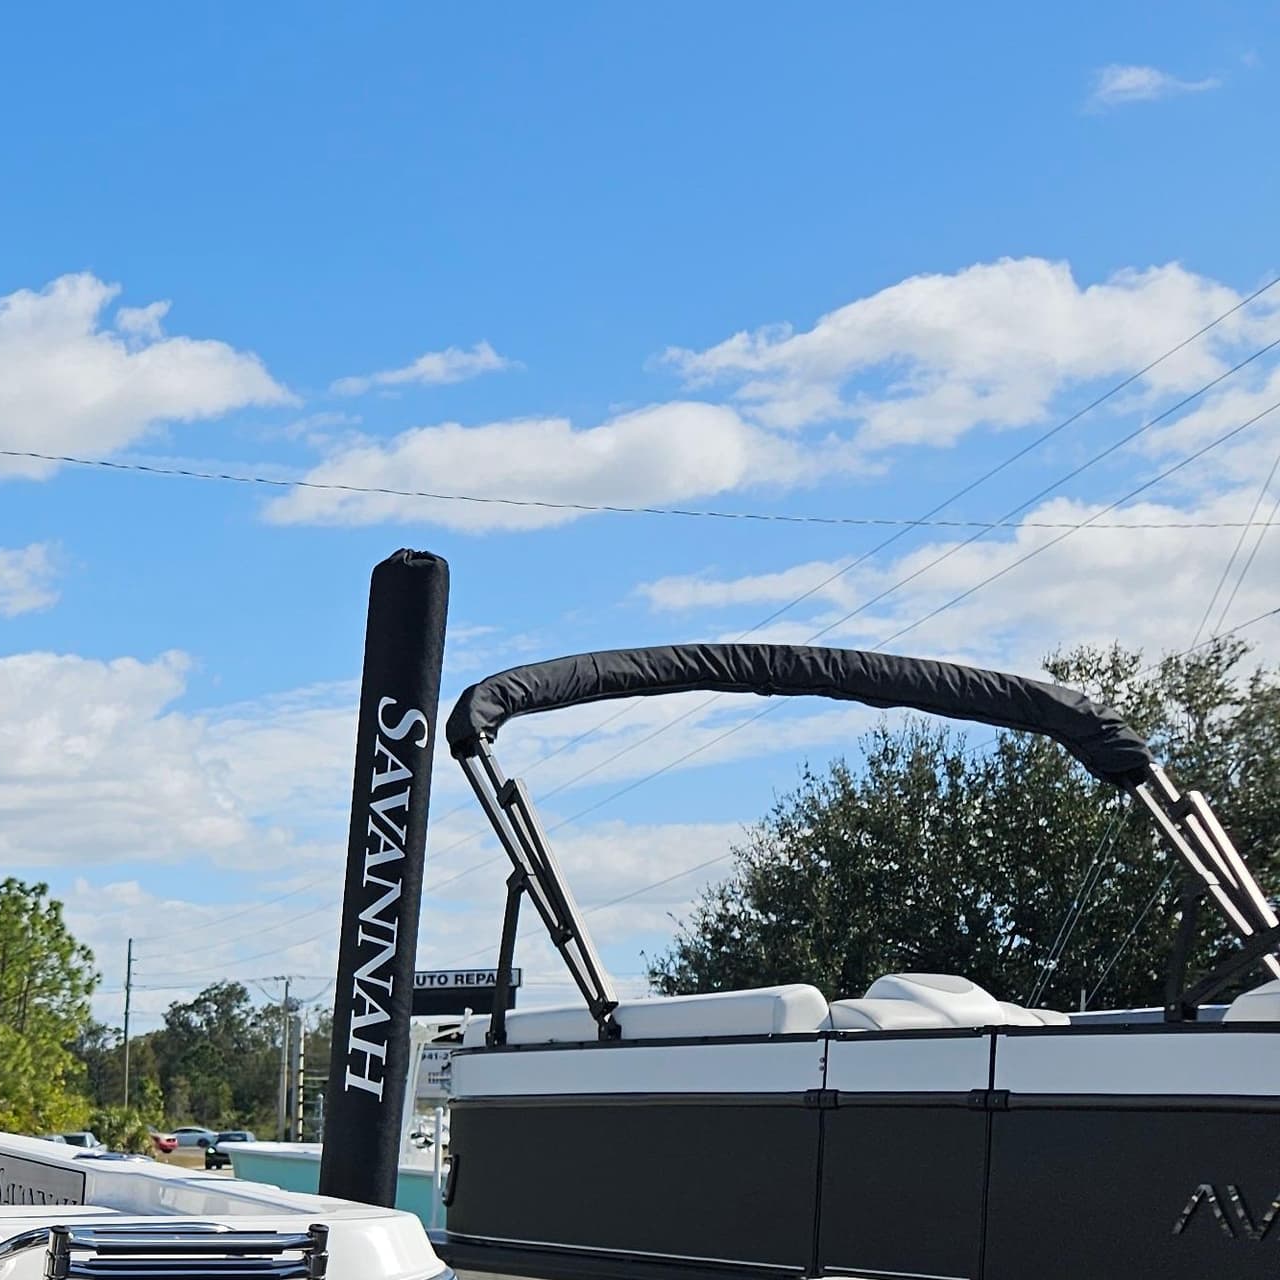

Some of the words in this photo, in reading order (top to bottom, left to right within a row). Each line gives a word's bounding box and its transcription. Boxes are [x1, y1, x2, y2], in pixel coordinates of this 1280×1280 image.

[344, 696, 429, 1103] SAVANNAH
[415, 973, 449, 986] UTO
[453, 973, 497, 986] REPA
